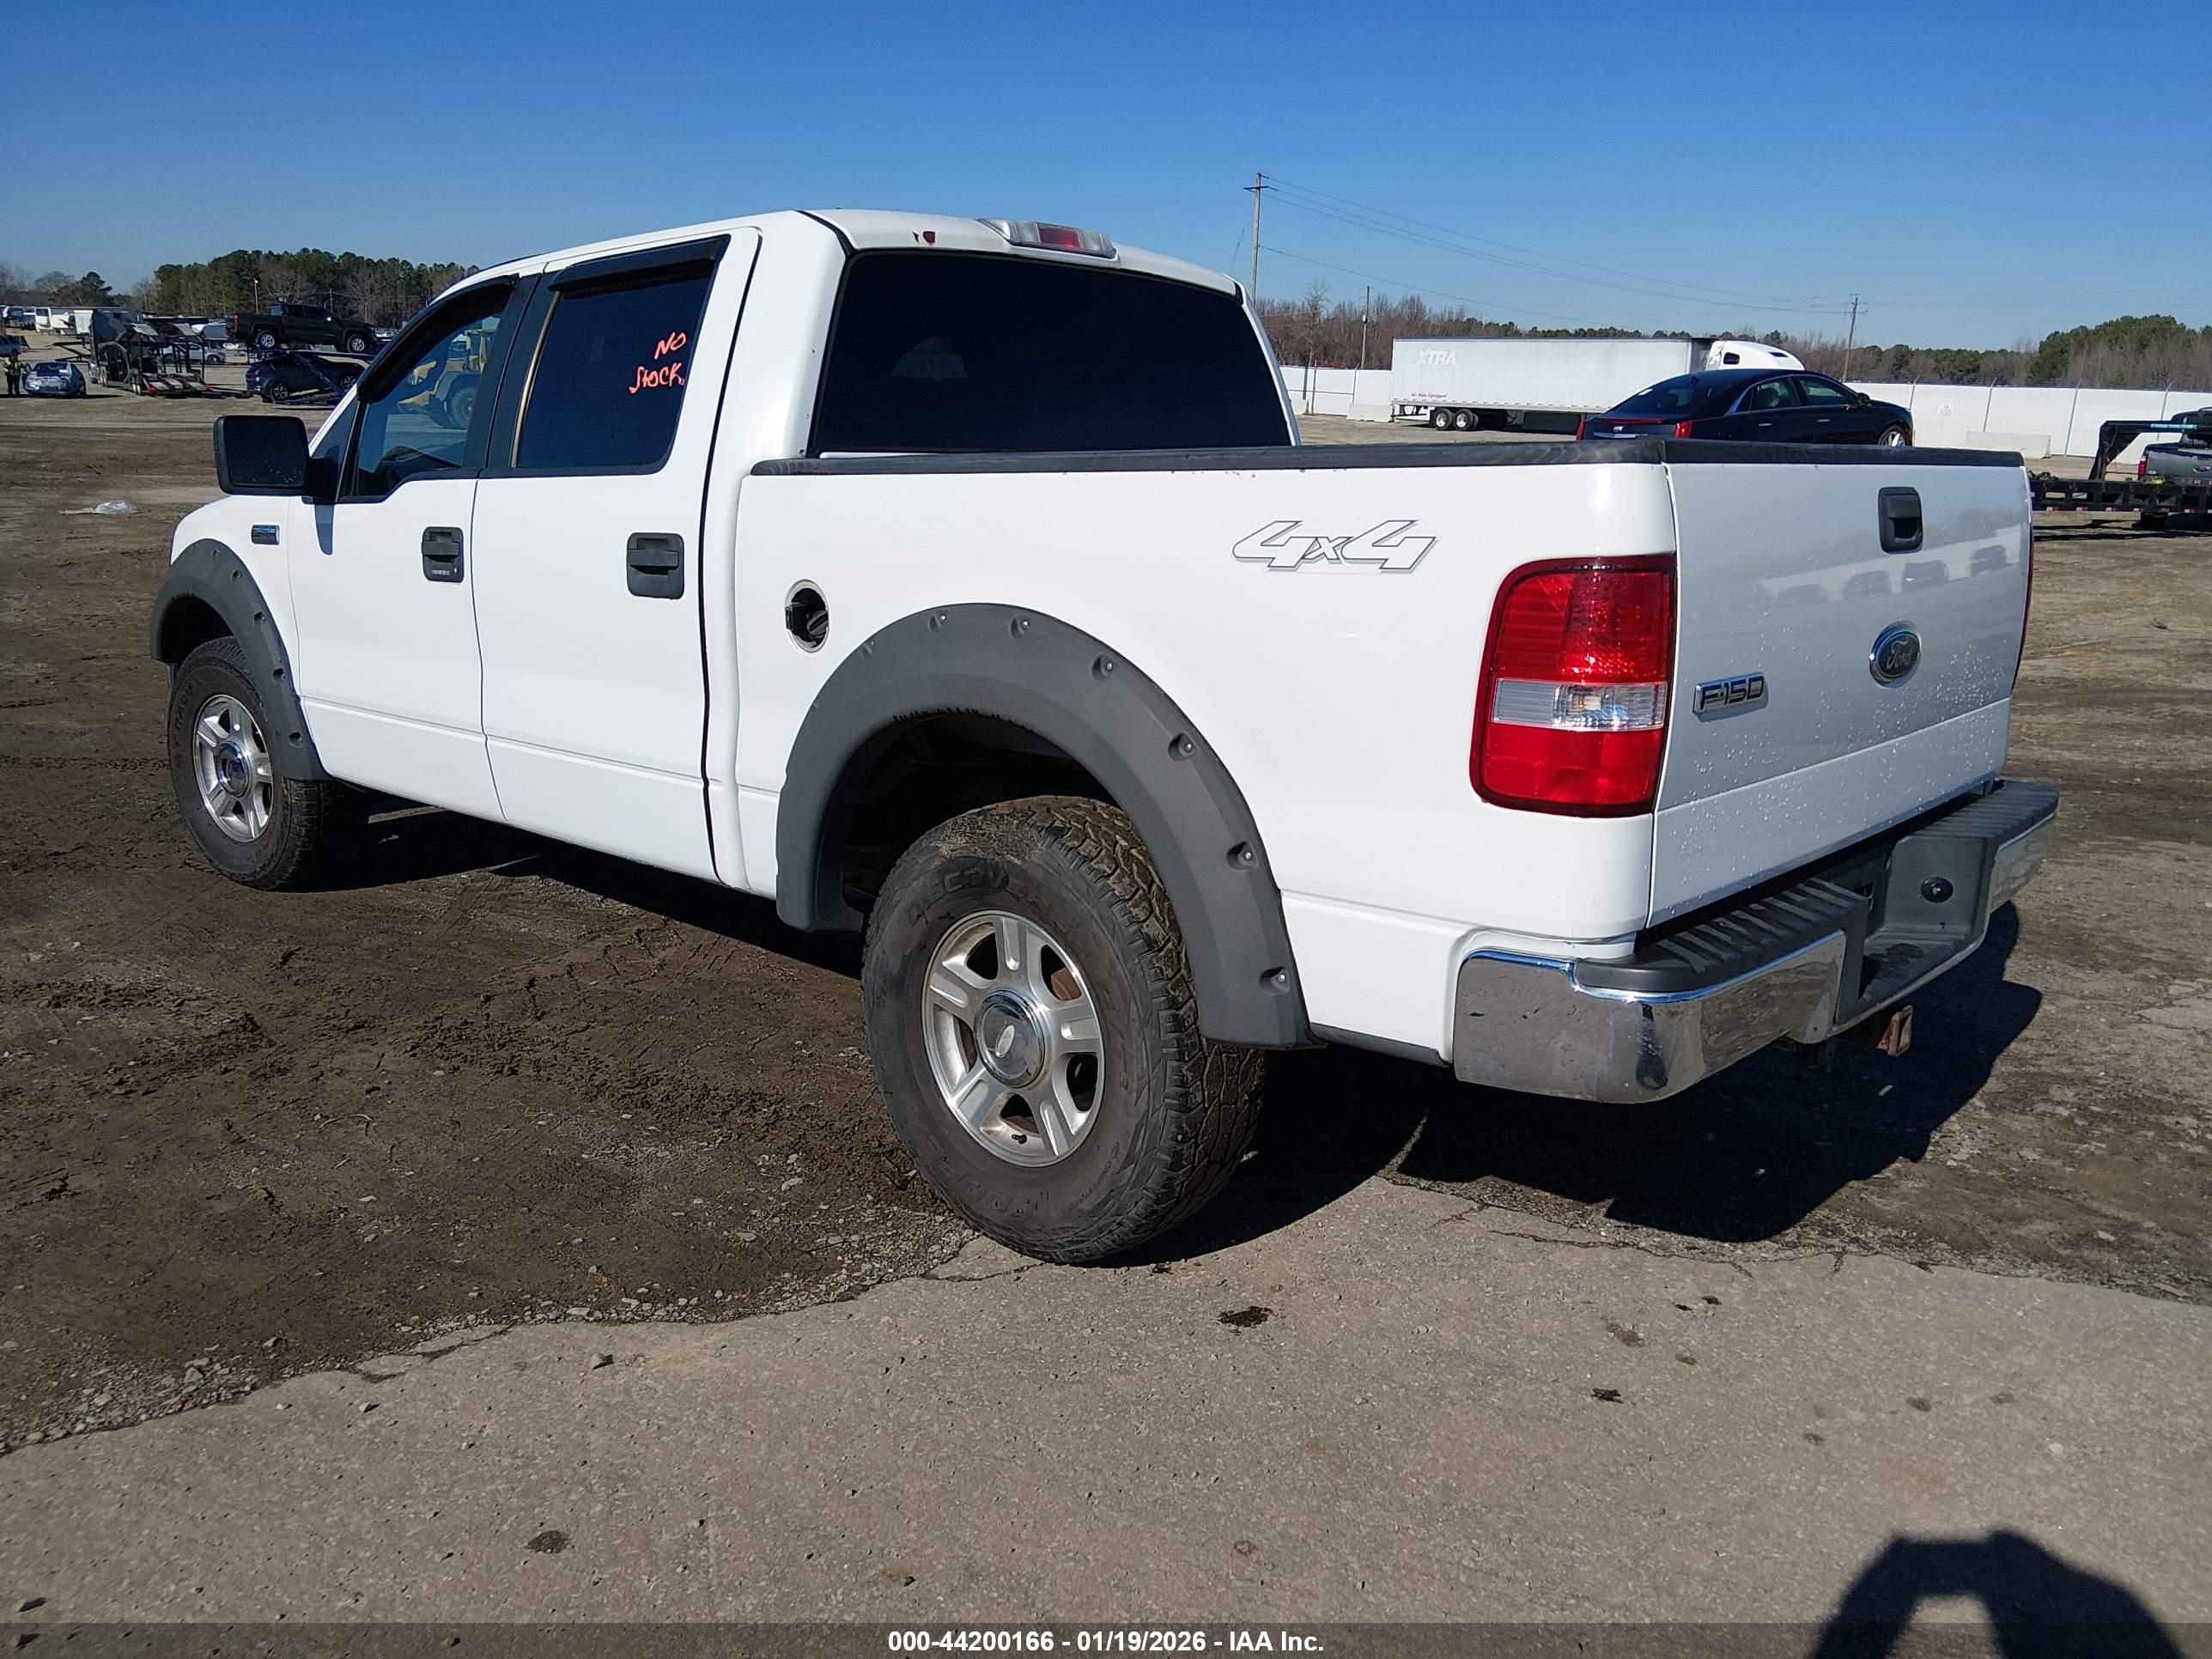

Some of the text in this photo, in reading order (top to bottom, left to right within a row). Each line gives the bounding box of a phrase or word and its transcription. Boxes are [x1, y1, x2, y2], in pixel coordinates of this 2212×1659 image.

[654, 331, 687, 360] NO
[1417, 349, 1456, 366] XTRA
[1887, 641, 1914, 669] Ford
